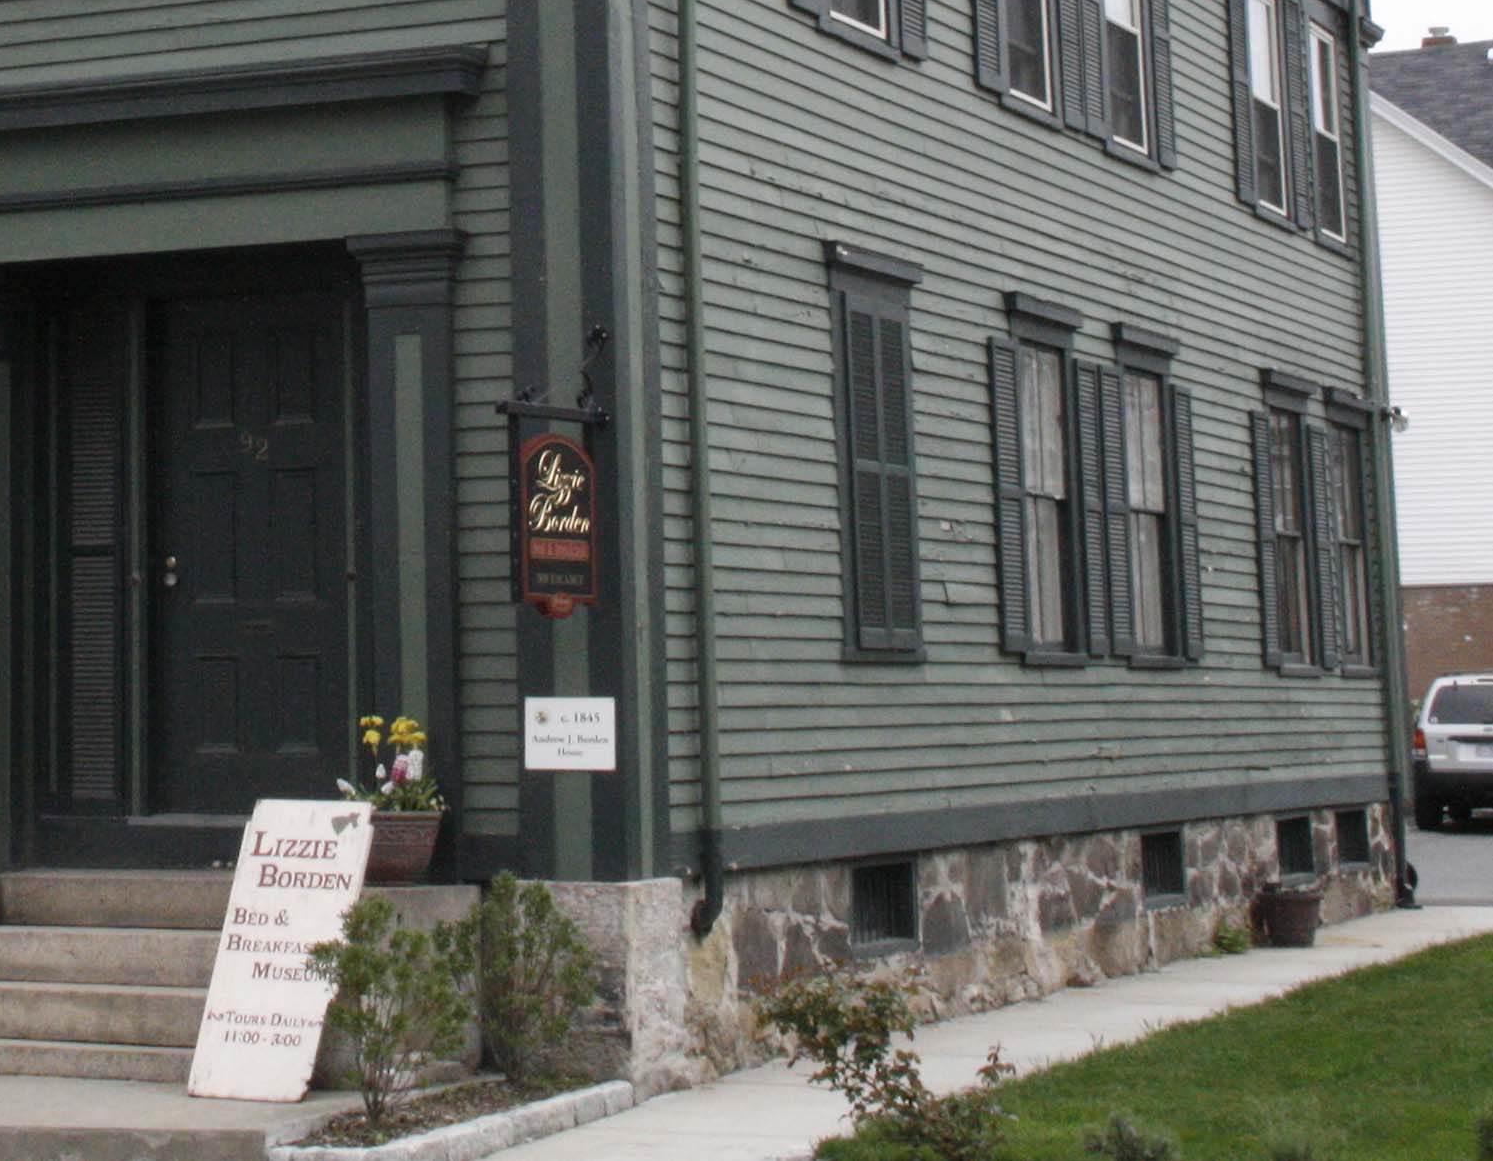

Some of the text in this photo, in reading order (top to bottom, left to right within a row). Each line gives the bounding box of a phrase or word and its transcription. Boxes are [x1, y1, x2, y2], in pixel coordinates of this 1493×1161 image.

[536, 449, 586, 505] Lizzie
[529, 493, 591, 533] Borden
[573, 711, 601, 724] 1845
[251, 831, 338, 860] LIZZIE
[258, 863, 352, 891] BORDEN
[232, 906, 290, 927] BED &
[226, 934, 312, 955] BREAKFAS
